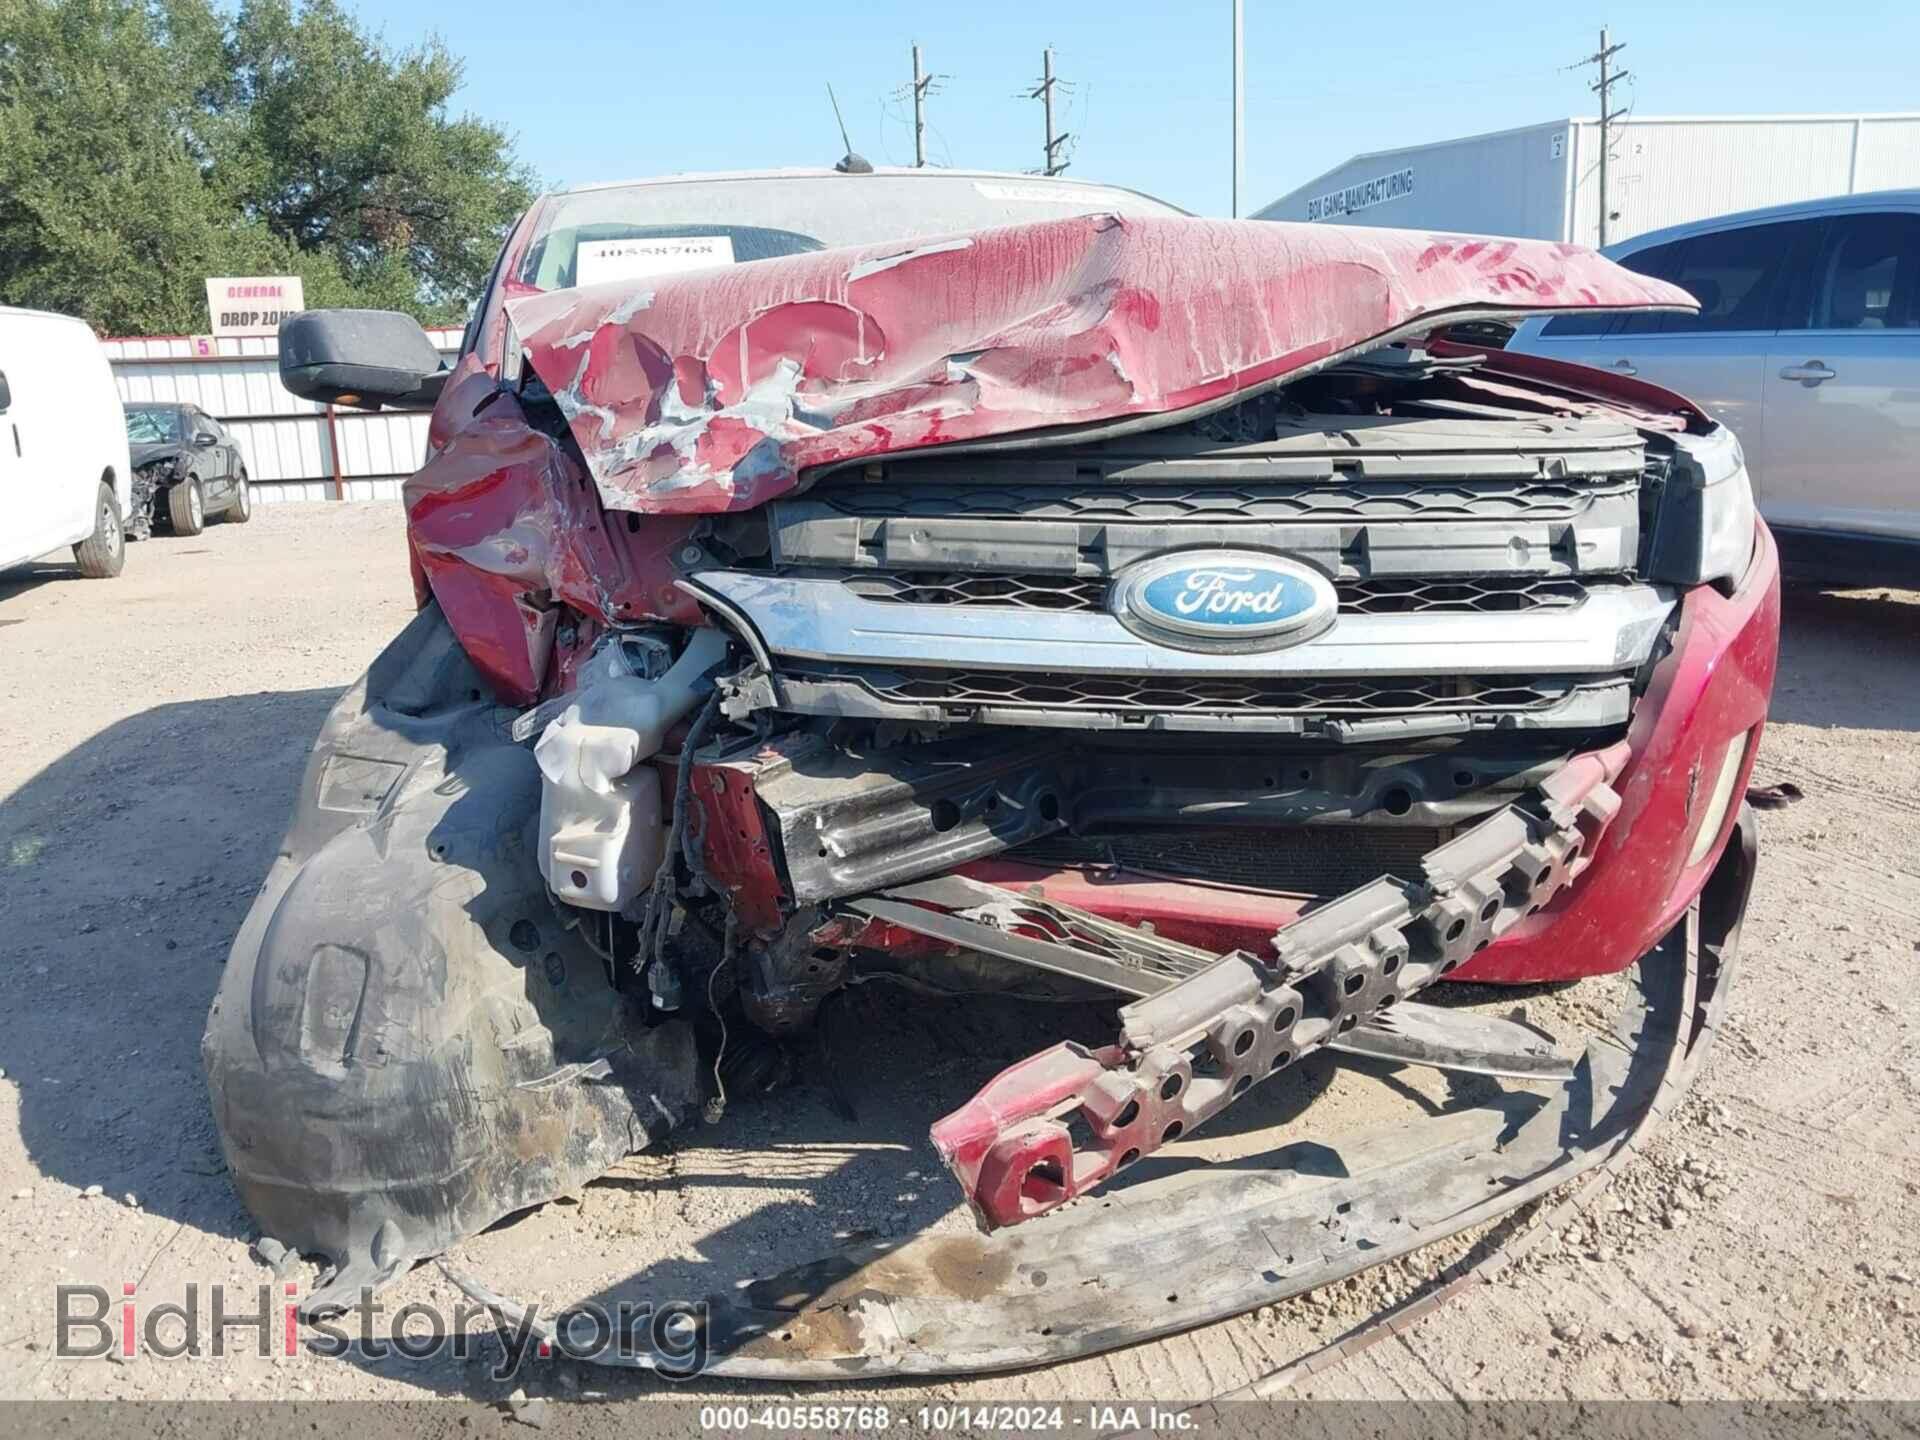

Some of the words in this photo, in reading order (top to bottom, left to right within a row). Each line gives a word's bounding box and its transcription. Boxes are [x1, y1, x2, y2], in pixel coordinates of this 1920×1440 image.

[1635, 144, 1643, 154] 2
[1345, 169, 1414, 211] MANUFACTURING
[228, 286, 283, 298] GENERAL
[220, 312, 259, 327] DROP
[261, 310, 295, 326] ZON
[197, 338, 209, 355] 5
[1175, 570, 1284, 614] Ford
